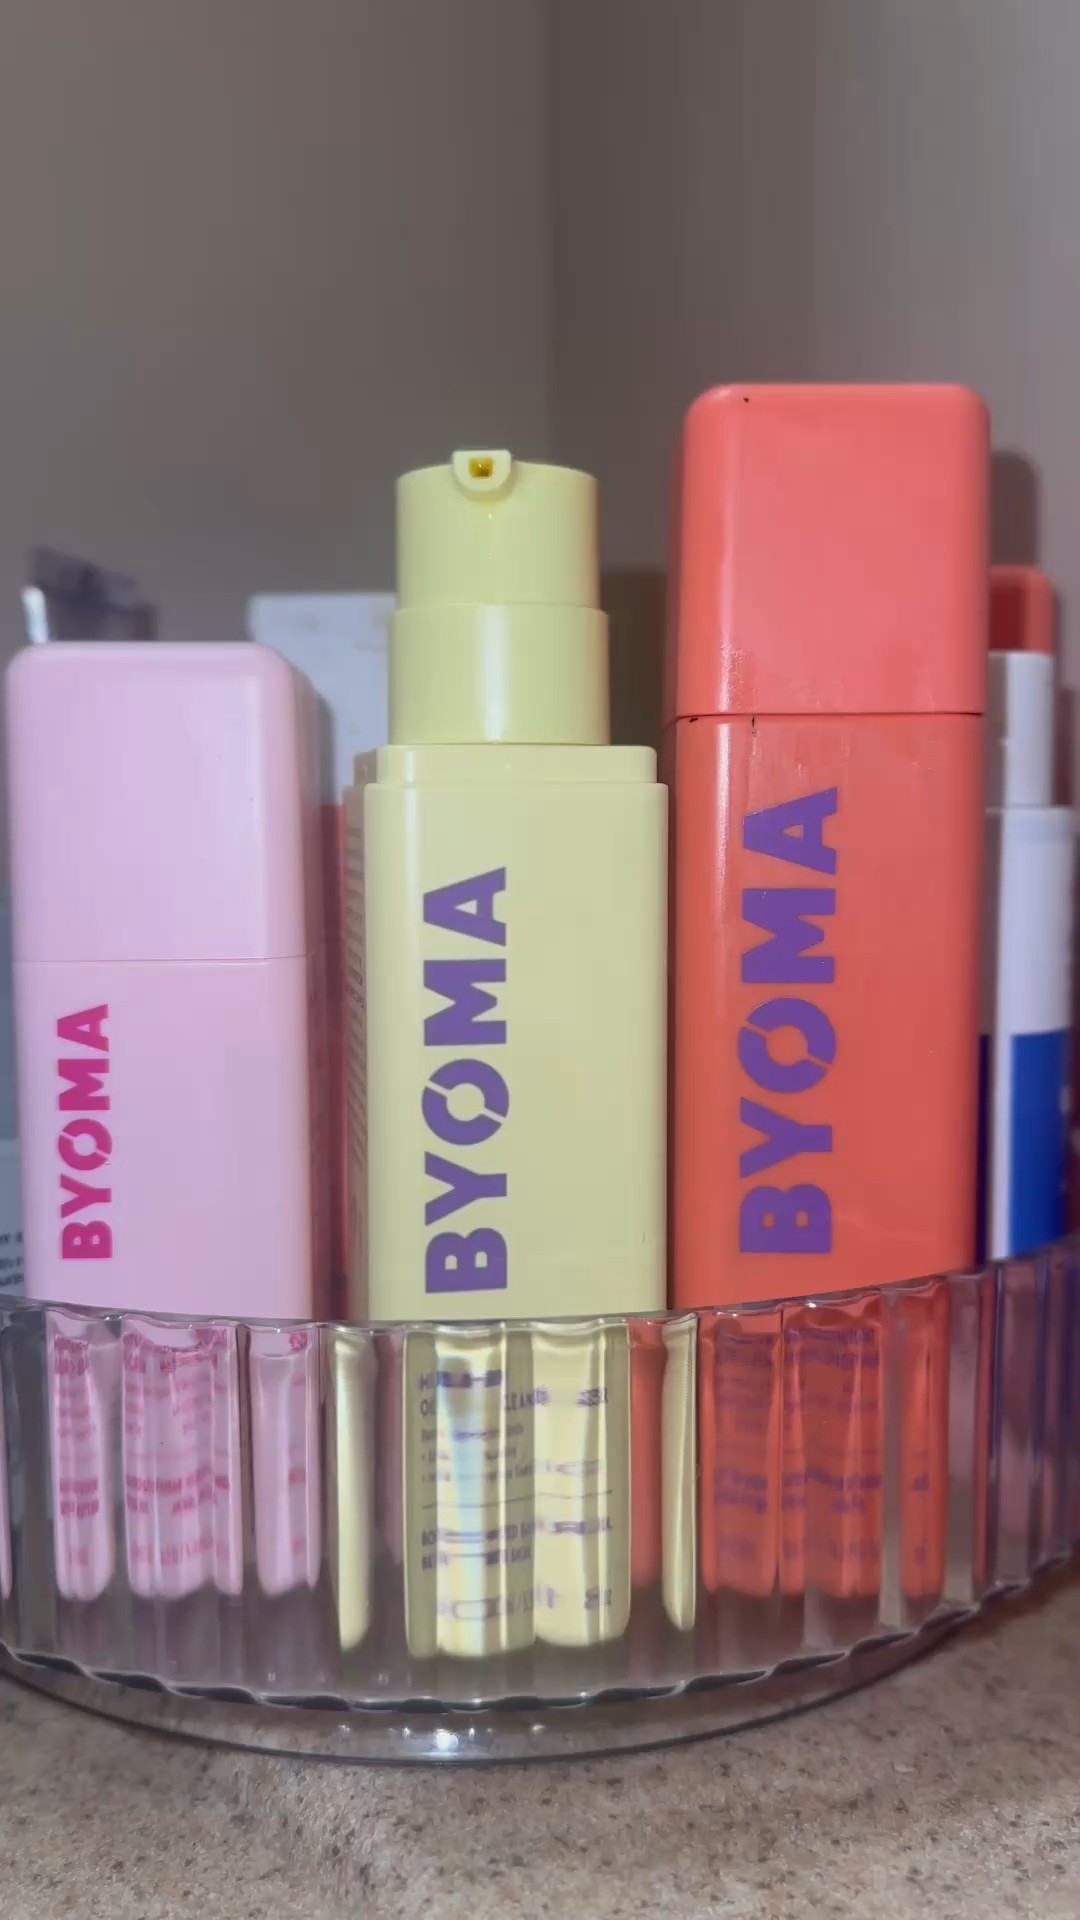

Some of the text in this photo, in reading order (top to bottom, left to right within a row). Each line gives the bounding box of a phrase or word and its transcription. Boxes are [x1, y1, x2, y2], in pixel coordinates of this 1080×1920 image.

[57, 1004, 112, 1259] BYOMA
[422, 867, 509, 1292] BYOMA
[738, 787, 838, 1253] BYOMA
